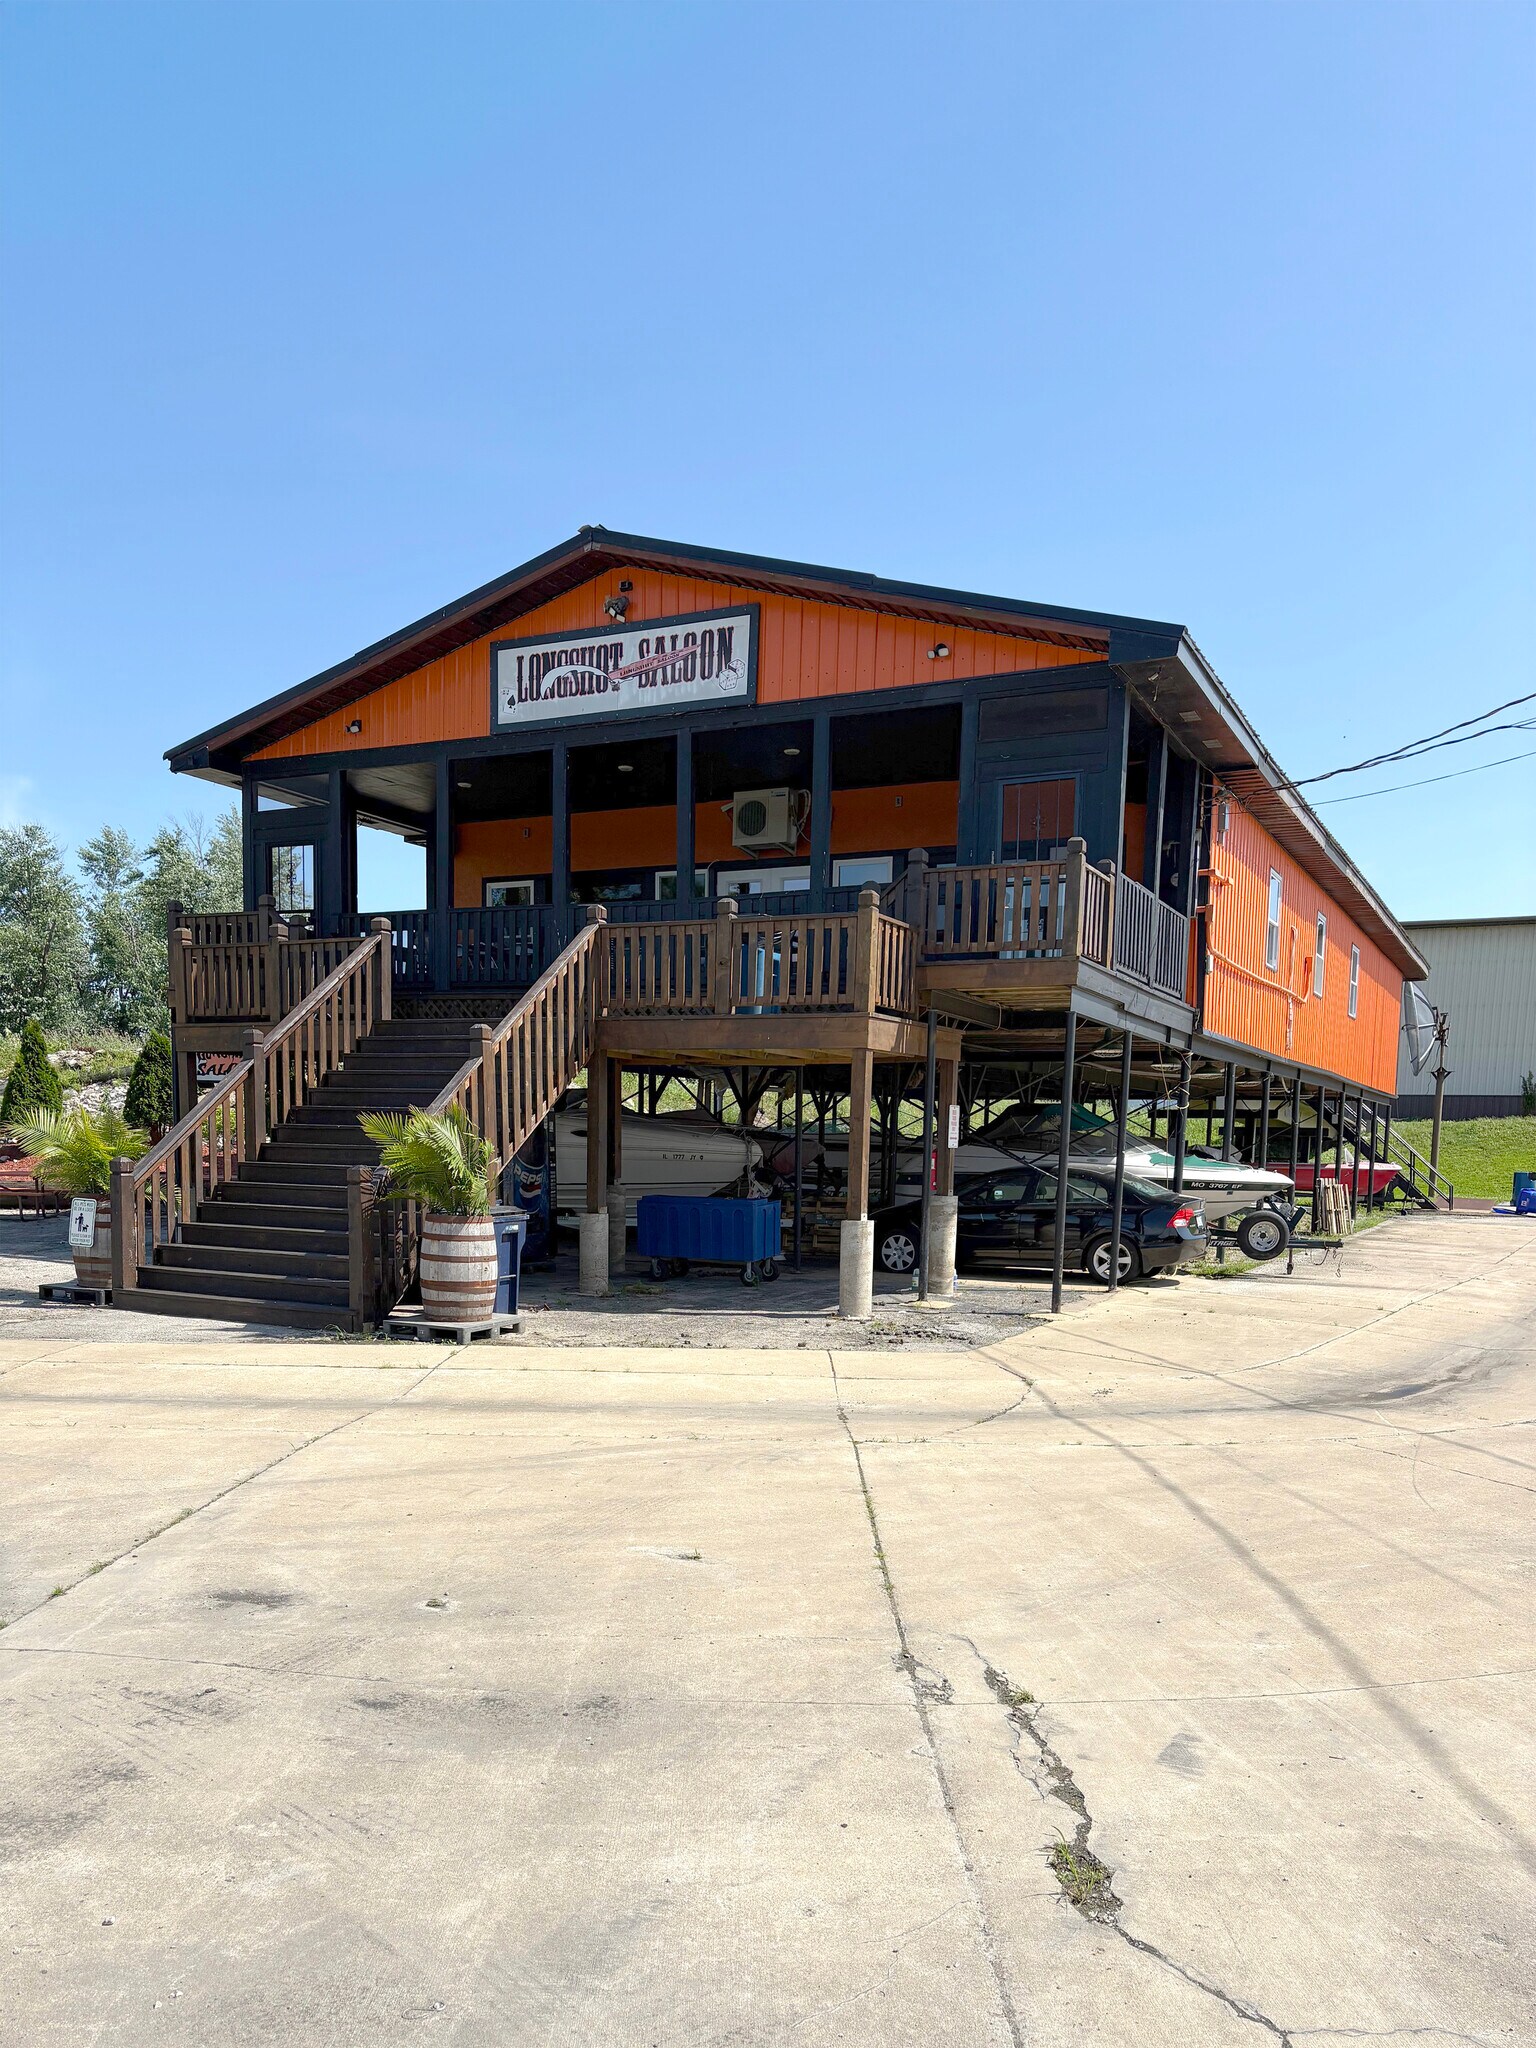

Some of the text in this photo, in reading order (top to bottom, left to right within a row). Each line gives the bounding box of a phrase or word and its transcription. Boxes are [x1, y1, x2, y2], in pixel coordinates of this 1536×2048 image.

[516, 626, 734, 704] LONGSHOT SALOON
[657, 653, 680, 664] SALOON
[514, 1163, 543, 1185] PEPS
